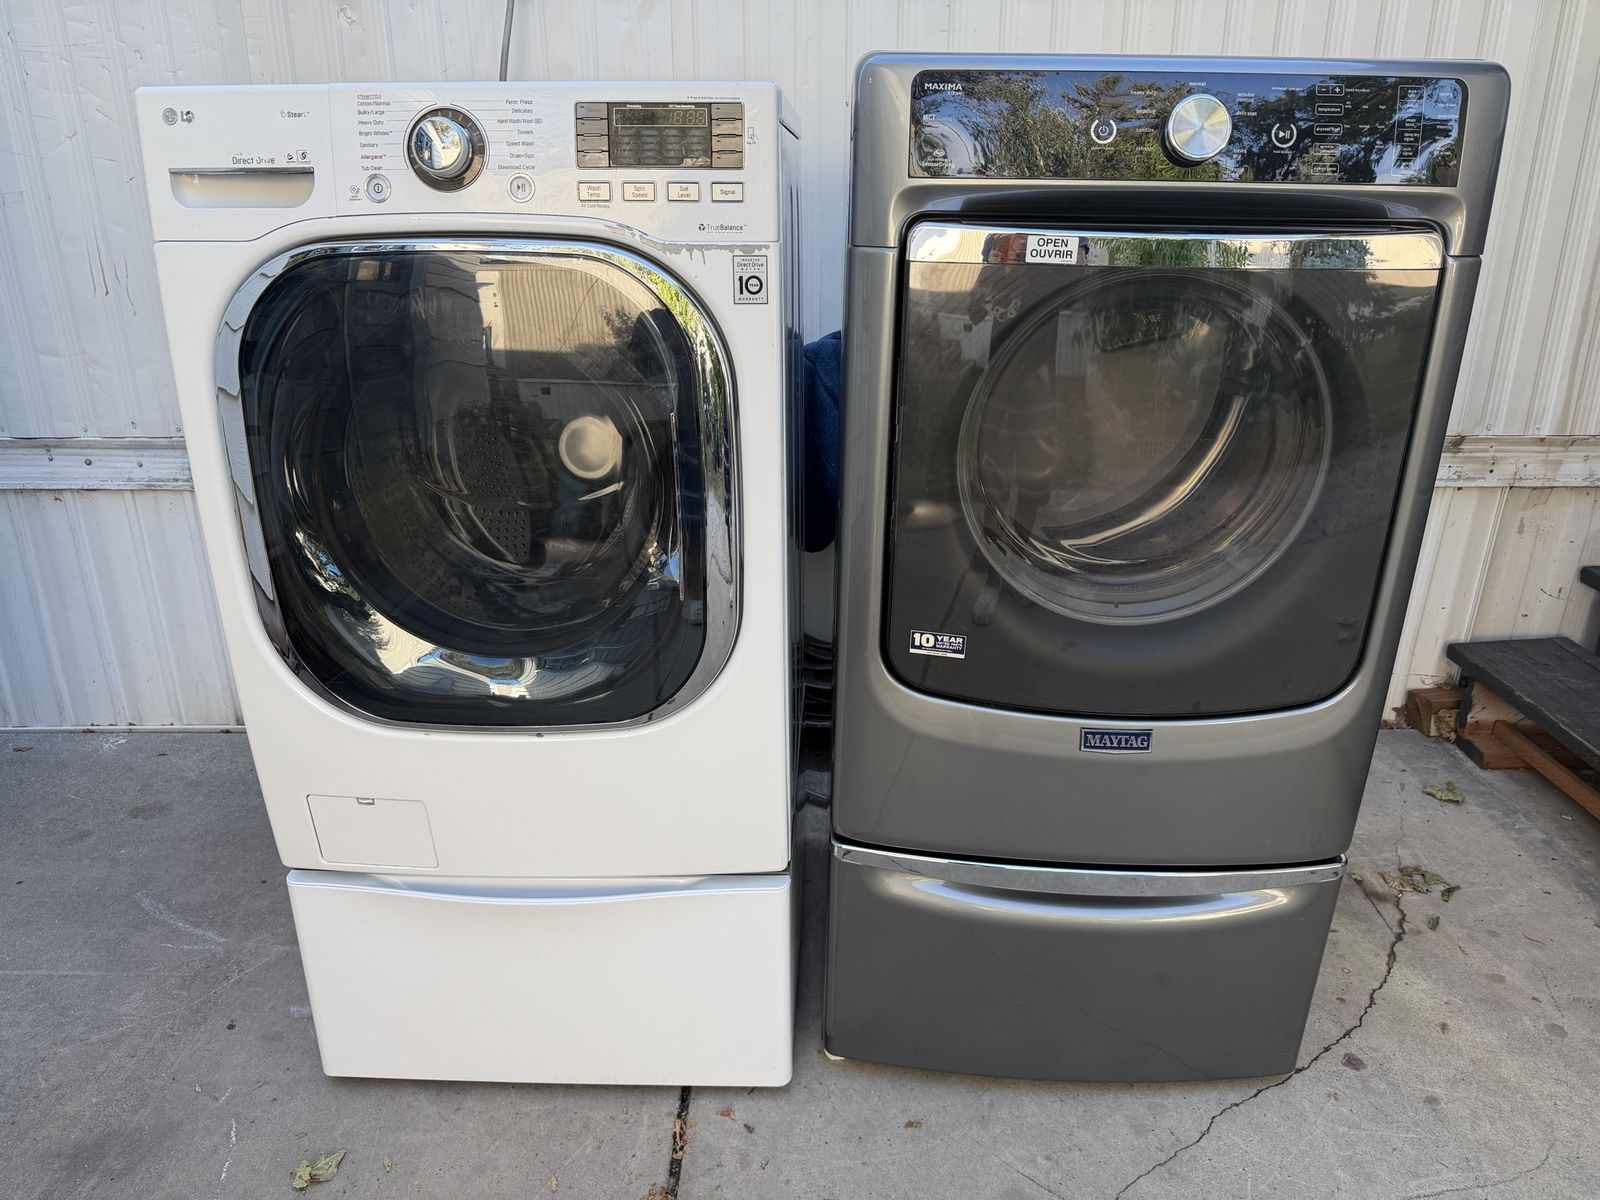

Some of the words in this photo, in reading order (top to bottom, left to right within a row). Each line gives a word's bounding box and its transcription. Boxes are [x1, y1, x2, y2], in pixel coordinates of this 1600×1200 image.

[924, 82, 962, 90] MAXIMA
[232, 156, 254, 165] Direct
[1037, 238, 1068, 248] OPEN
[1030, 248, 1074, 259] OUVRIR
[738, 275, 764, 296] 10
[914, 632, 935, 648] 10
[936, 635, 964, 644] YEAR
[1086, 734, 1148, 748] MAYTAG
